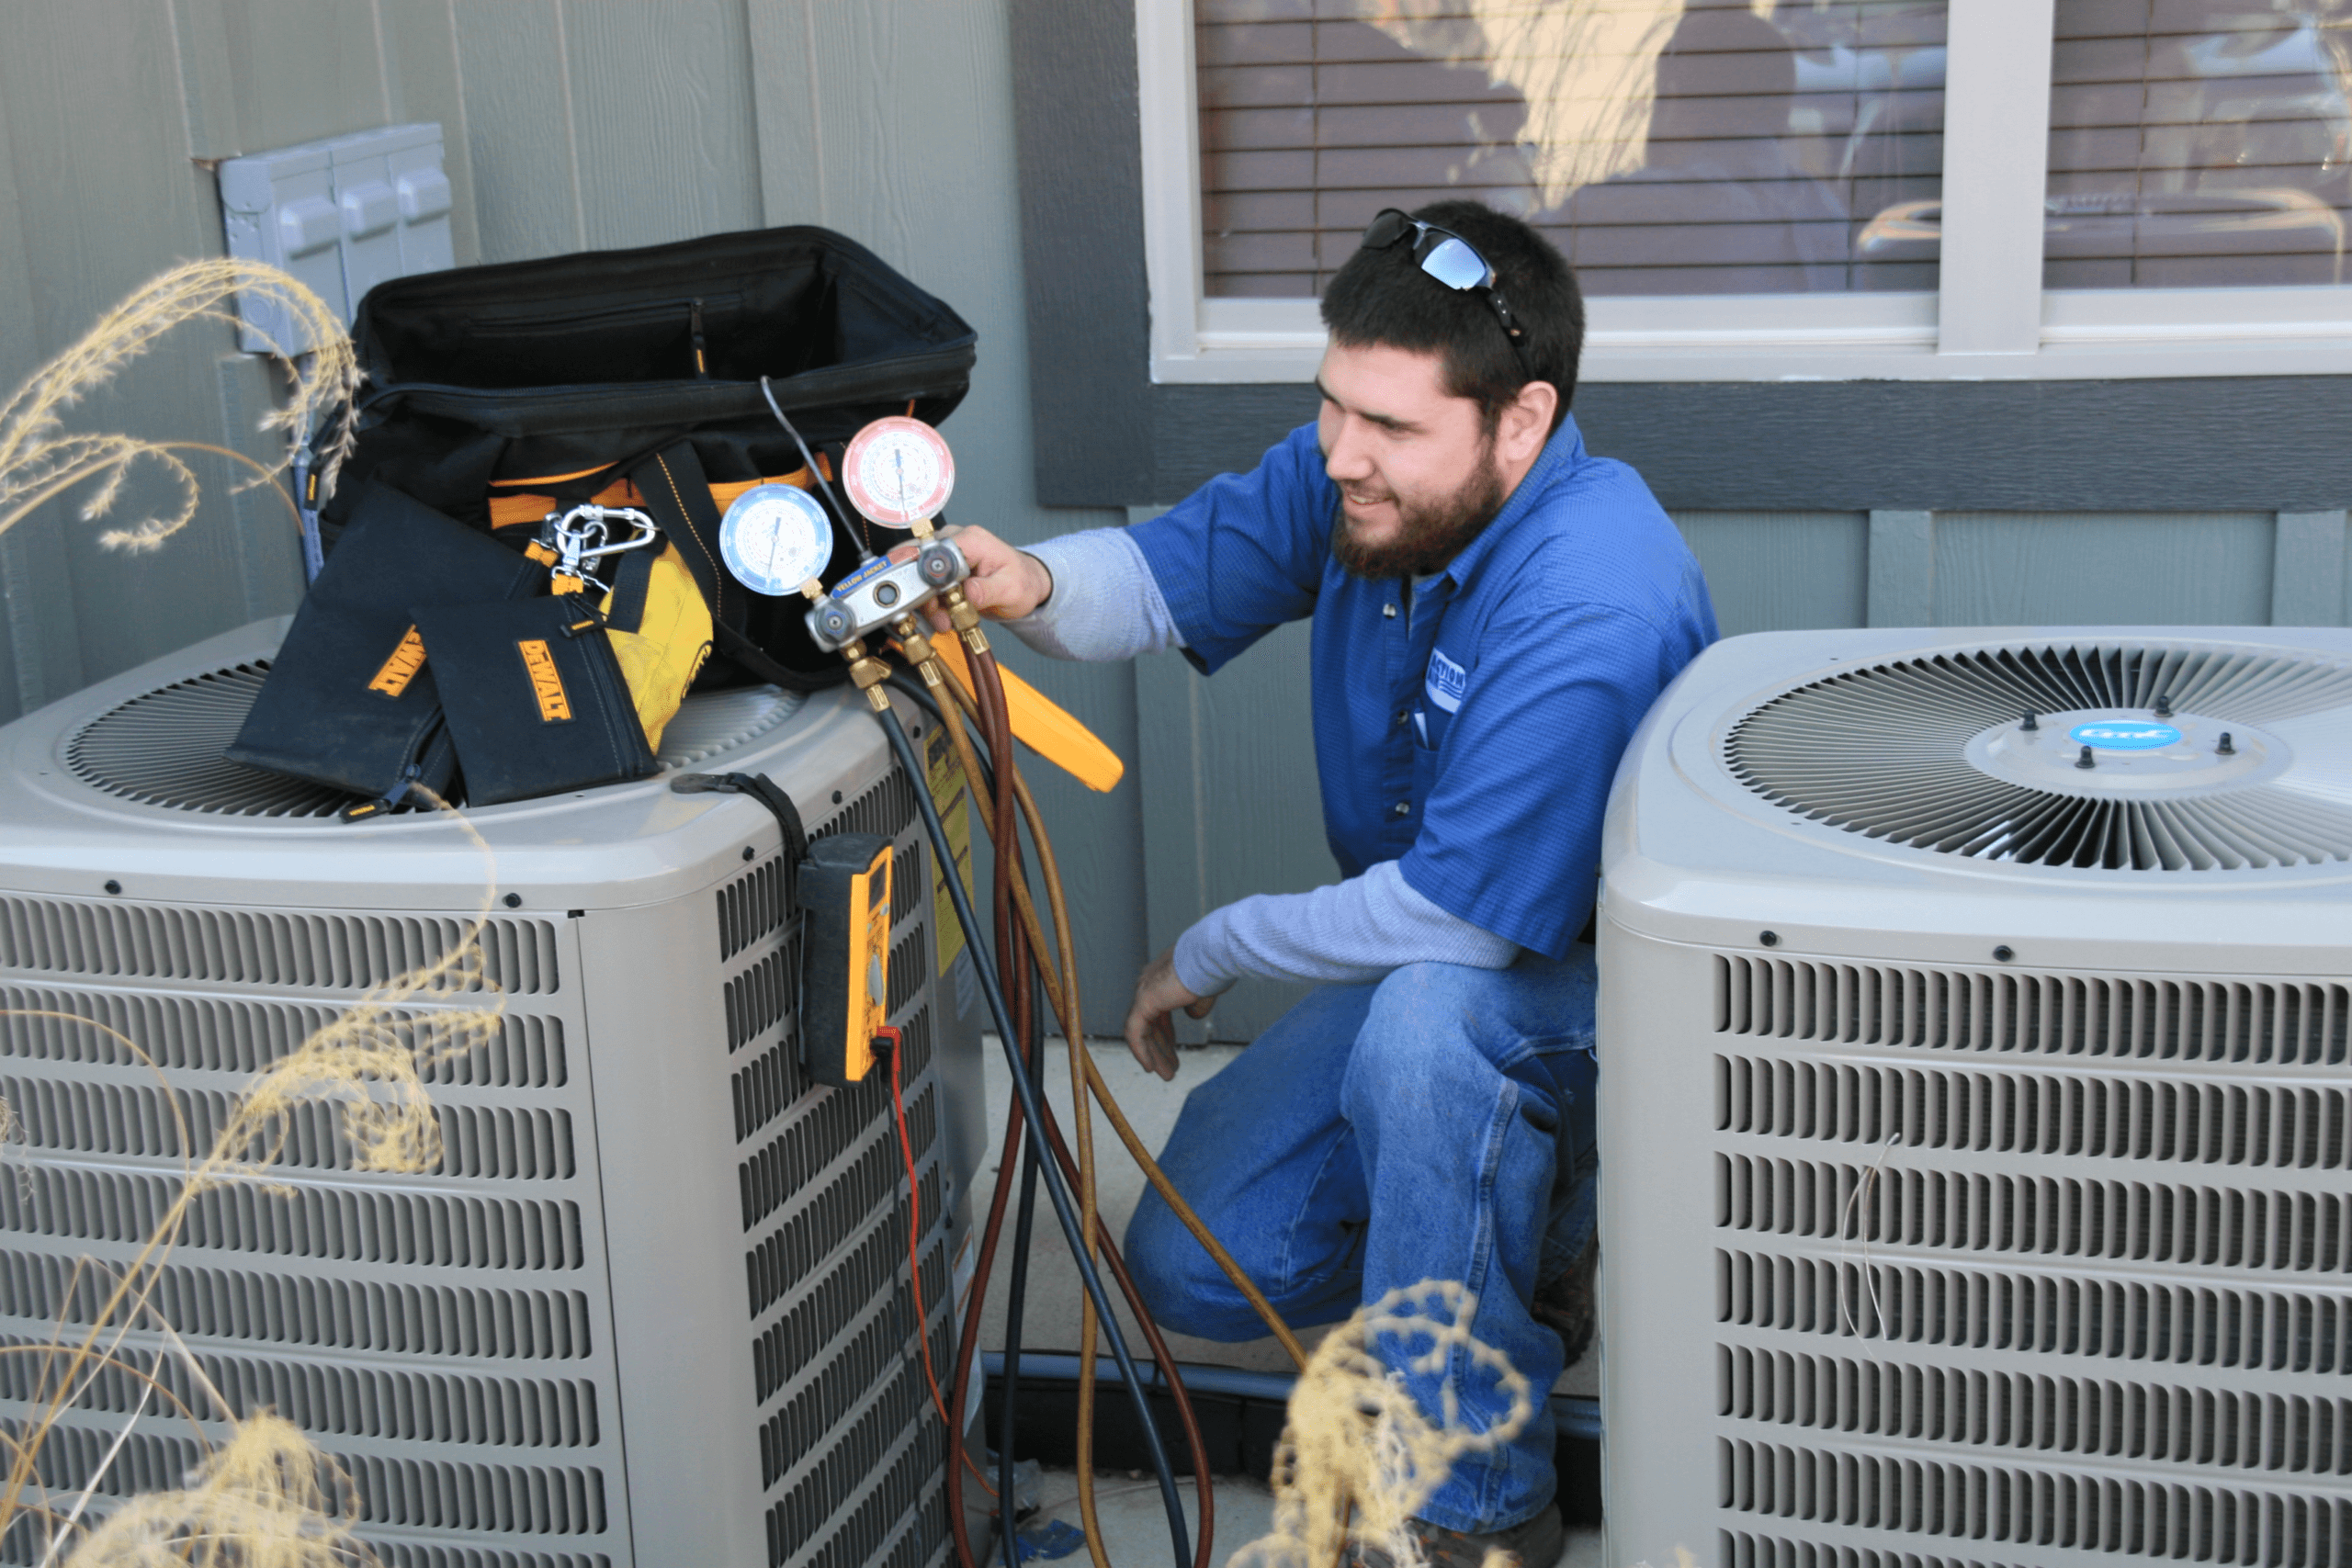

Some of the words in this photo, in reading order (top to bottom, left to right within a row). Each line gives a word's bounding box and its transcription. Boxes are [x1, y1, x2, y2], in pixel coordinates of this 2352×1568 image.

[836, 576, 863, 592] YELLOW
[865, 560, 887, 577] JACKET
[519, 640, 570, 721] DEWALT
